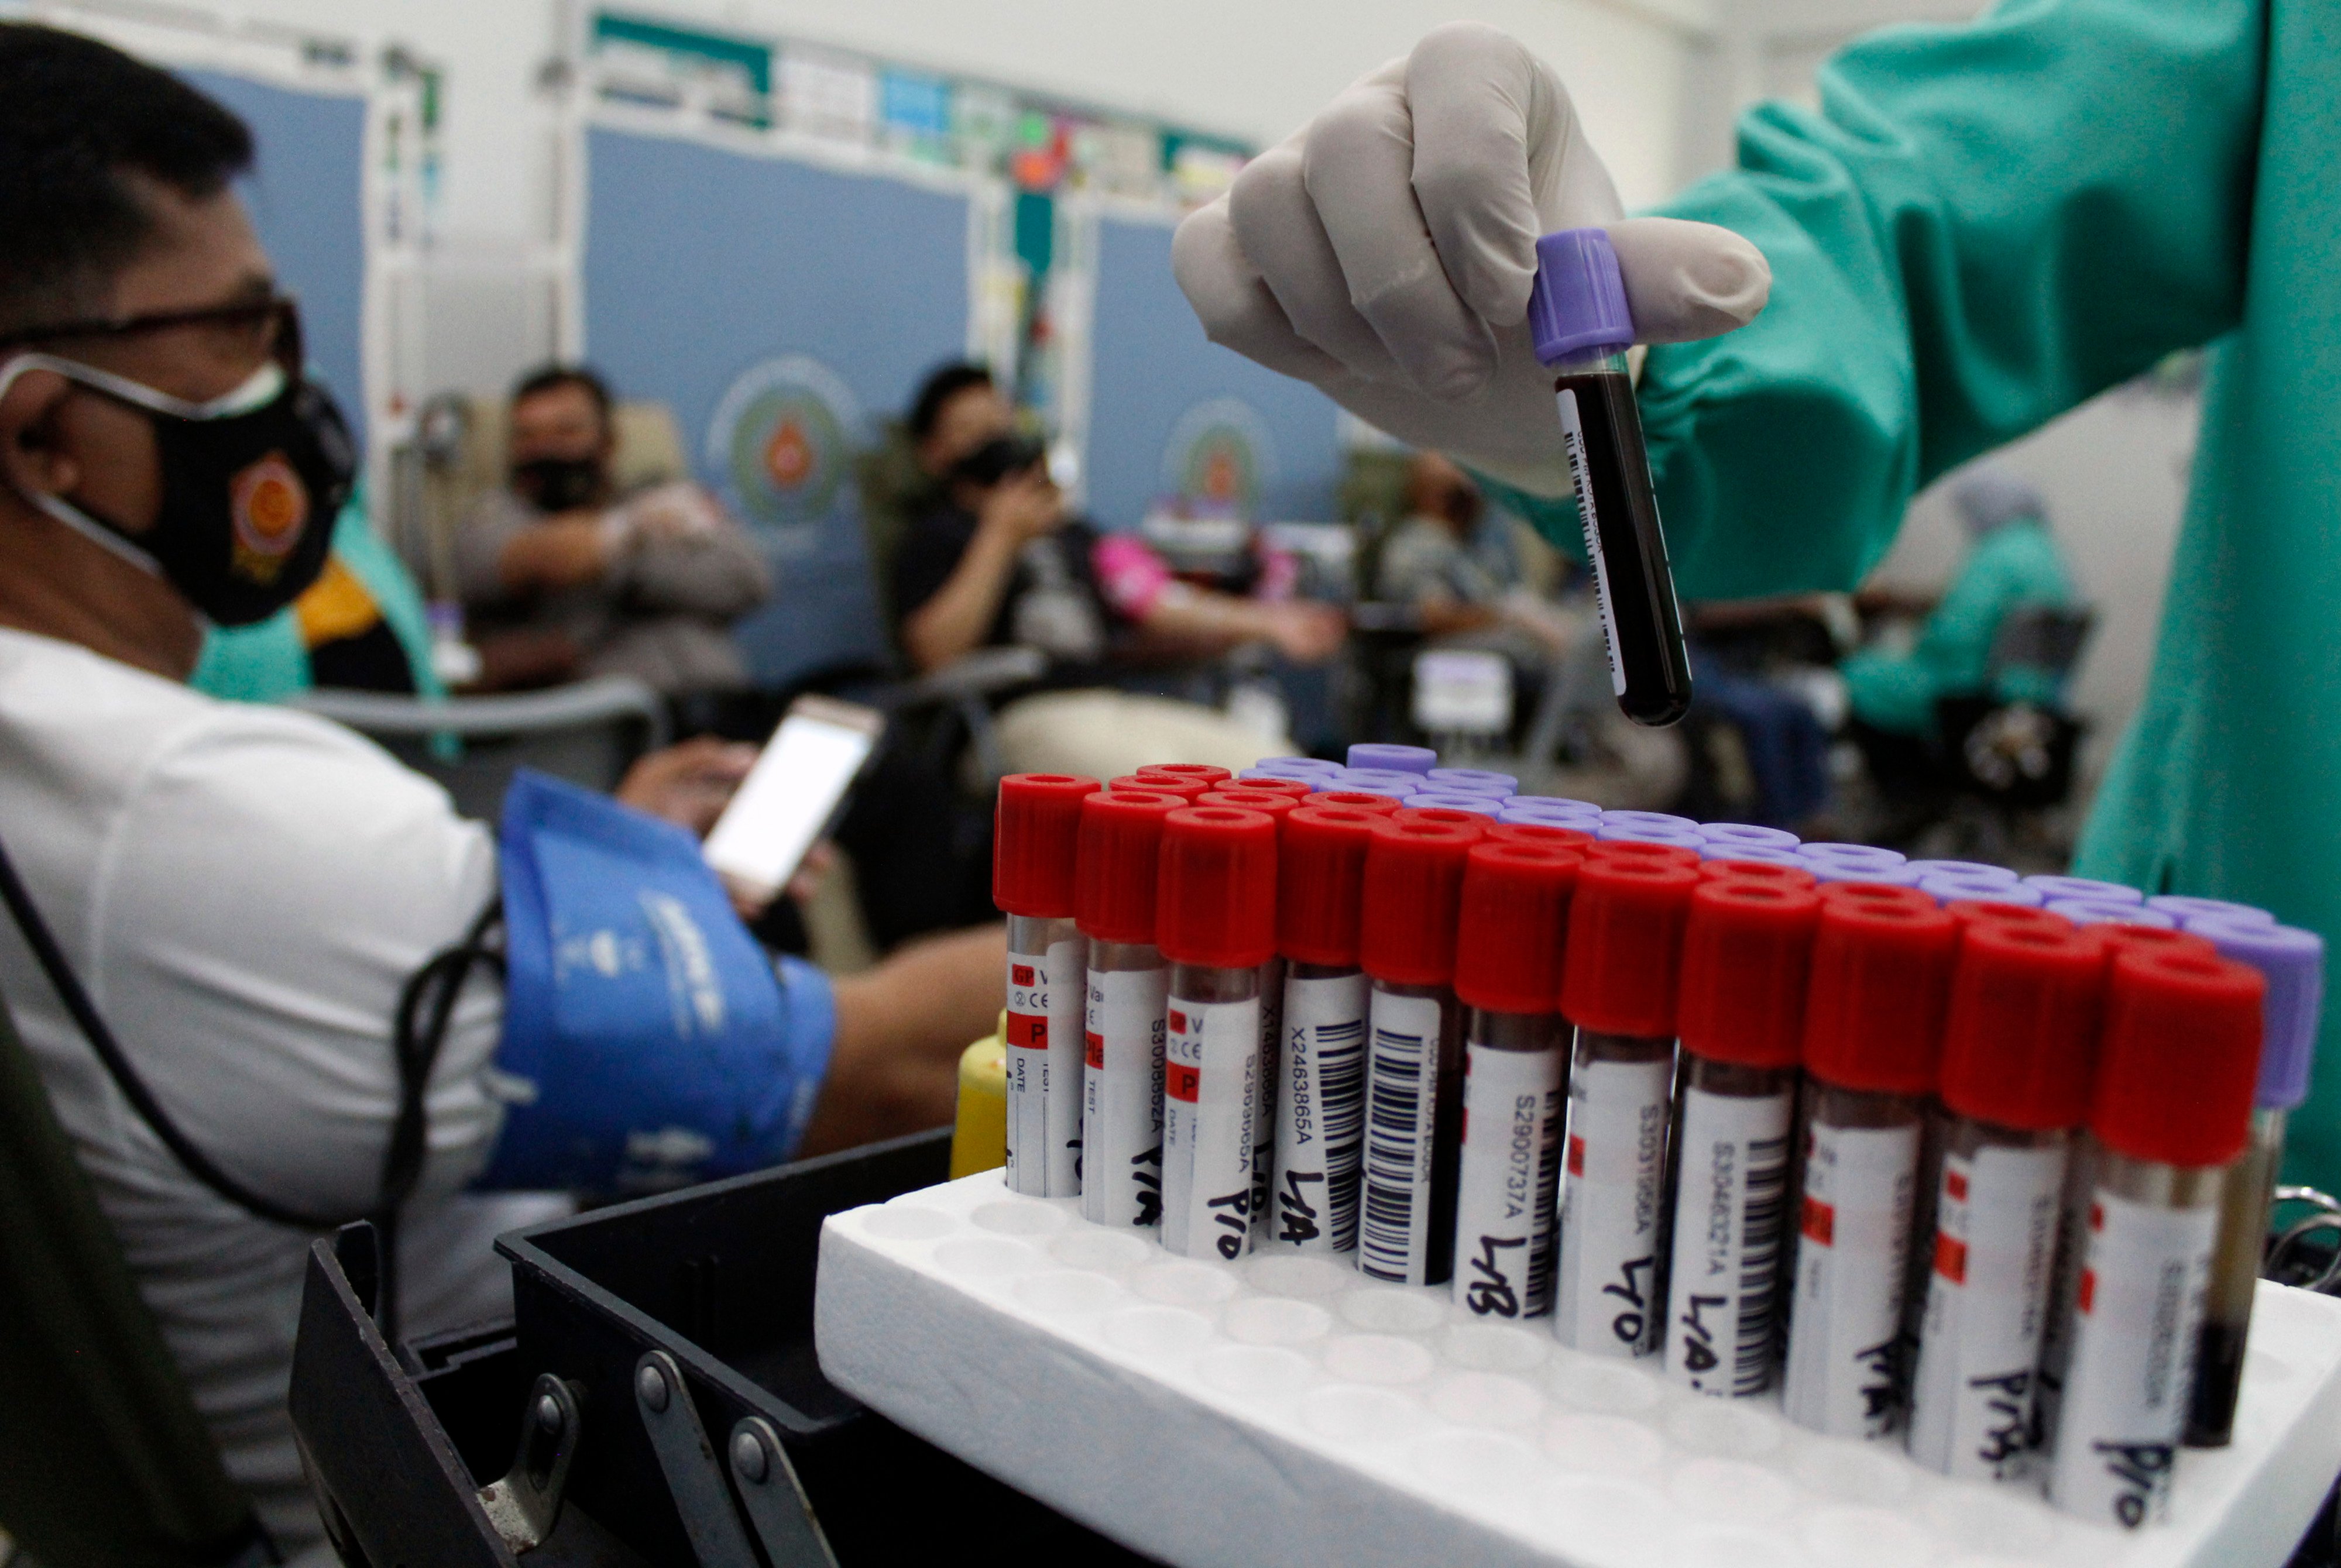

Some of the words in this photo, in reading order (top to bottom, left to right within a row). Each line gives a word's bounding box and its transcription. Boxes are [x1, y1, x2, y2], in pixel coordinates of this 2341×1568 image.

[1017, 1058, 1025, 1094] DATE
[1291, 1026, 1312, 1145] X2463865A
[1504, 1095, 1536, 1219] S2900737A
